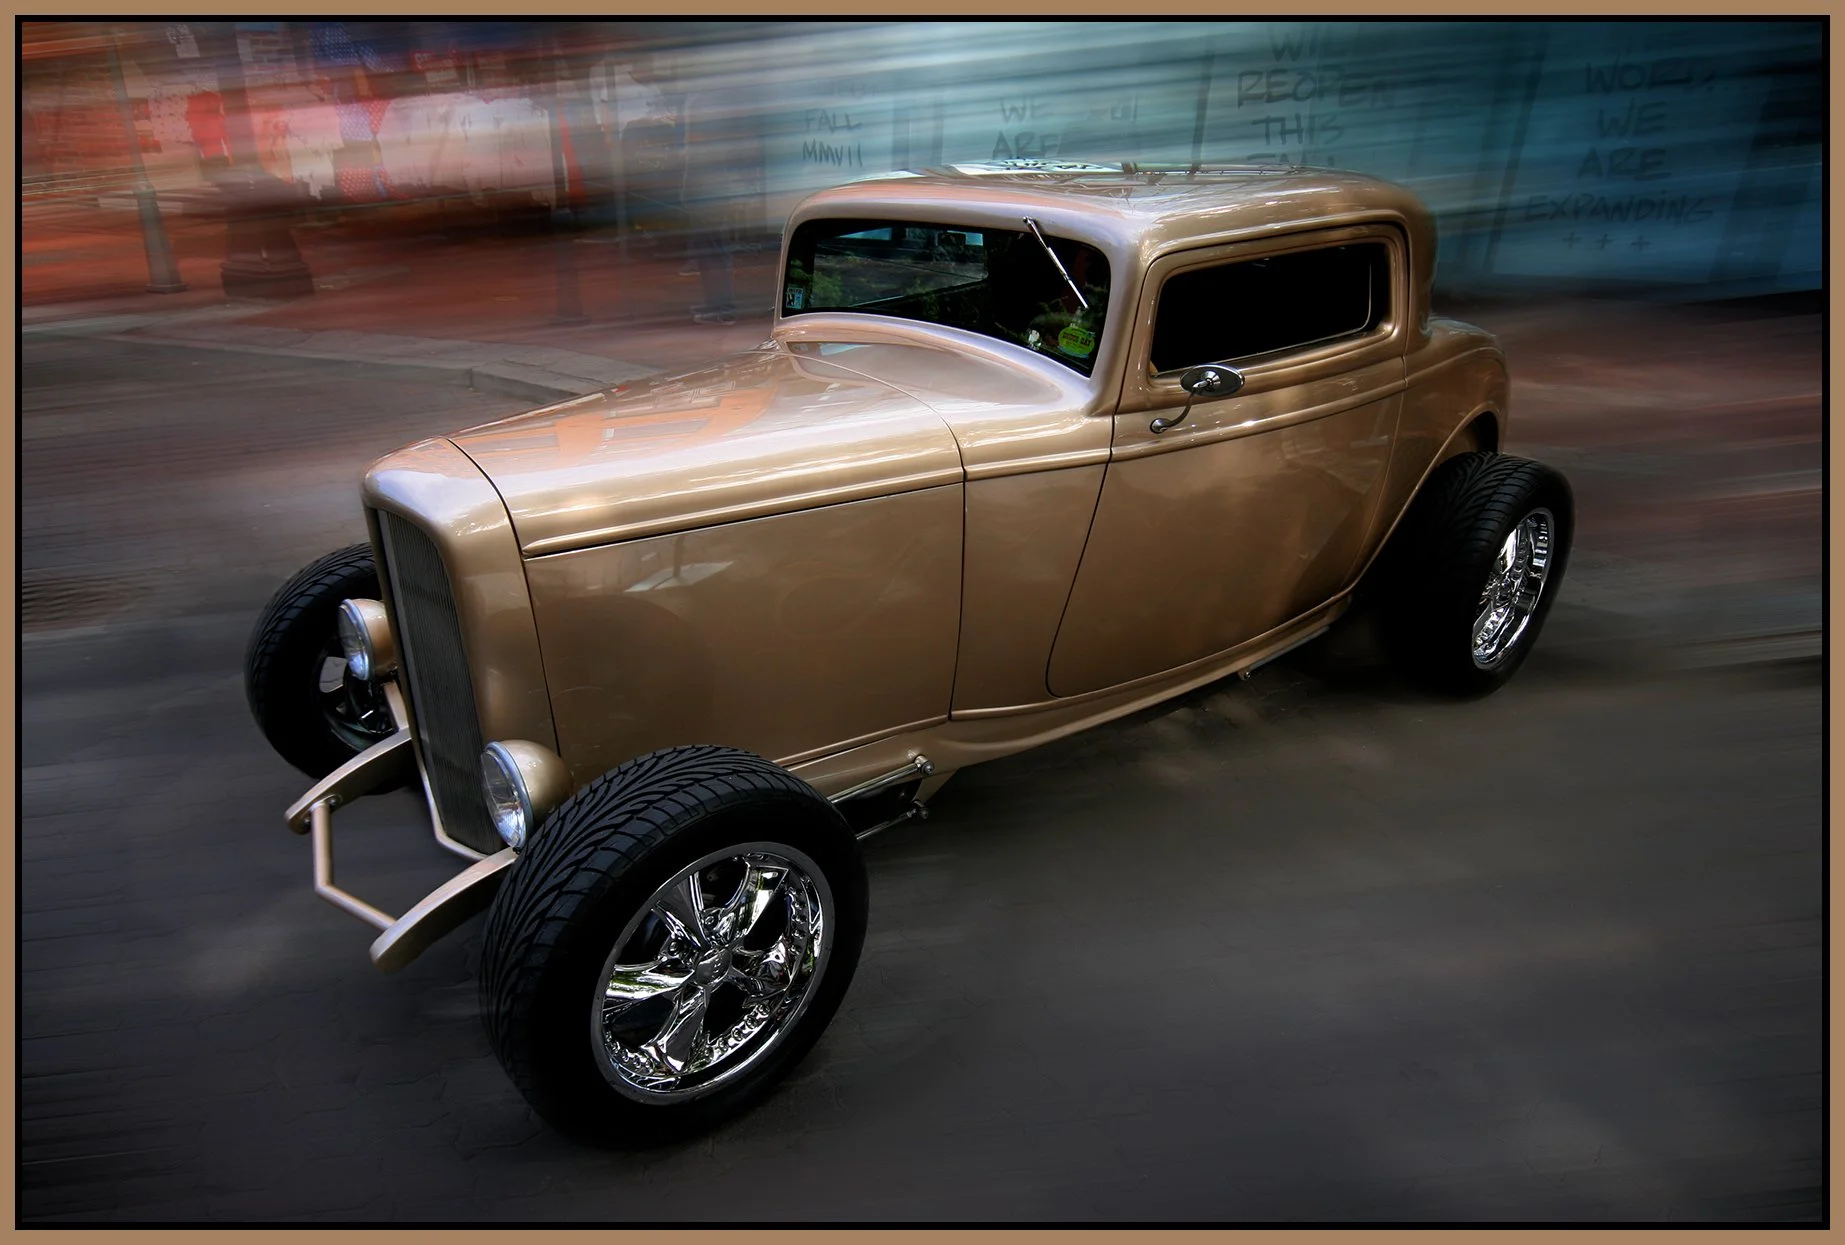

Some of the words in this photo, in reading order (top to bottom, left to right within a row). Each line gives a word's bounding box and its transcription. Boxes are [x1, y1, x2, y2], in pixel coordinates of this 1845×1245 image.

[804, 108, 863, 134] FALL
[1251, 113, 1345, 146] THIS
[1597, 98, 1668, 137] WE
[802, 138, 864, 169] MMVII
[1577, 146, 1673, 181] ARE
[1525, 189, 1715, 223] EXPANDING
